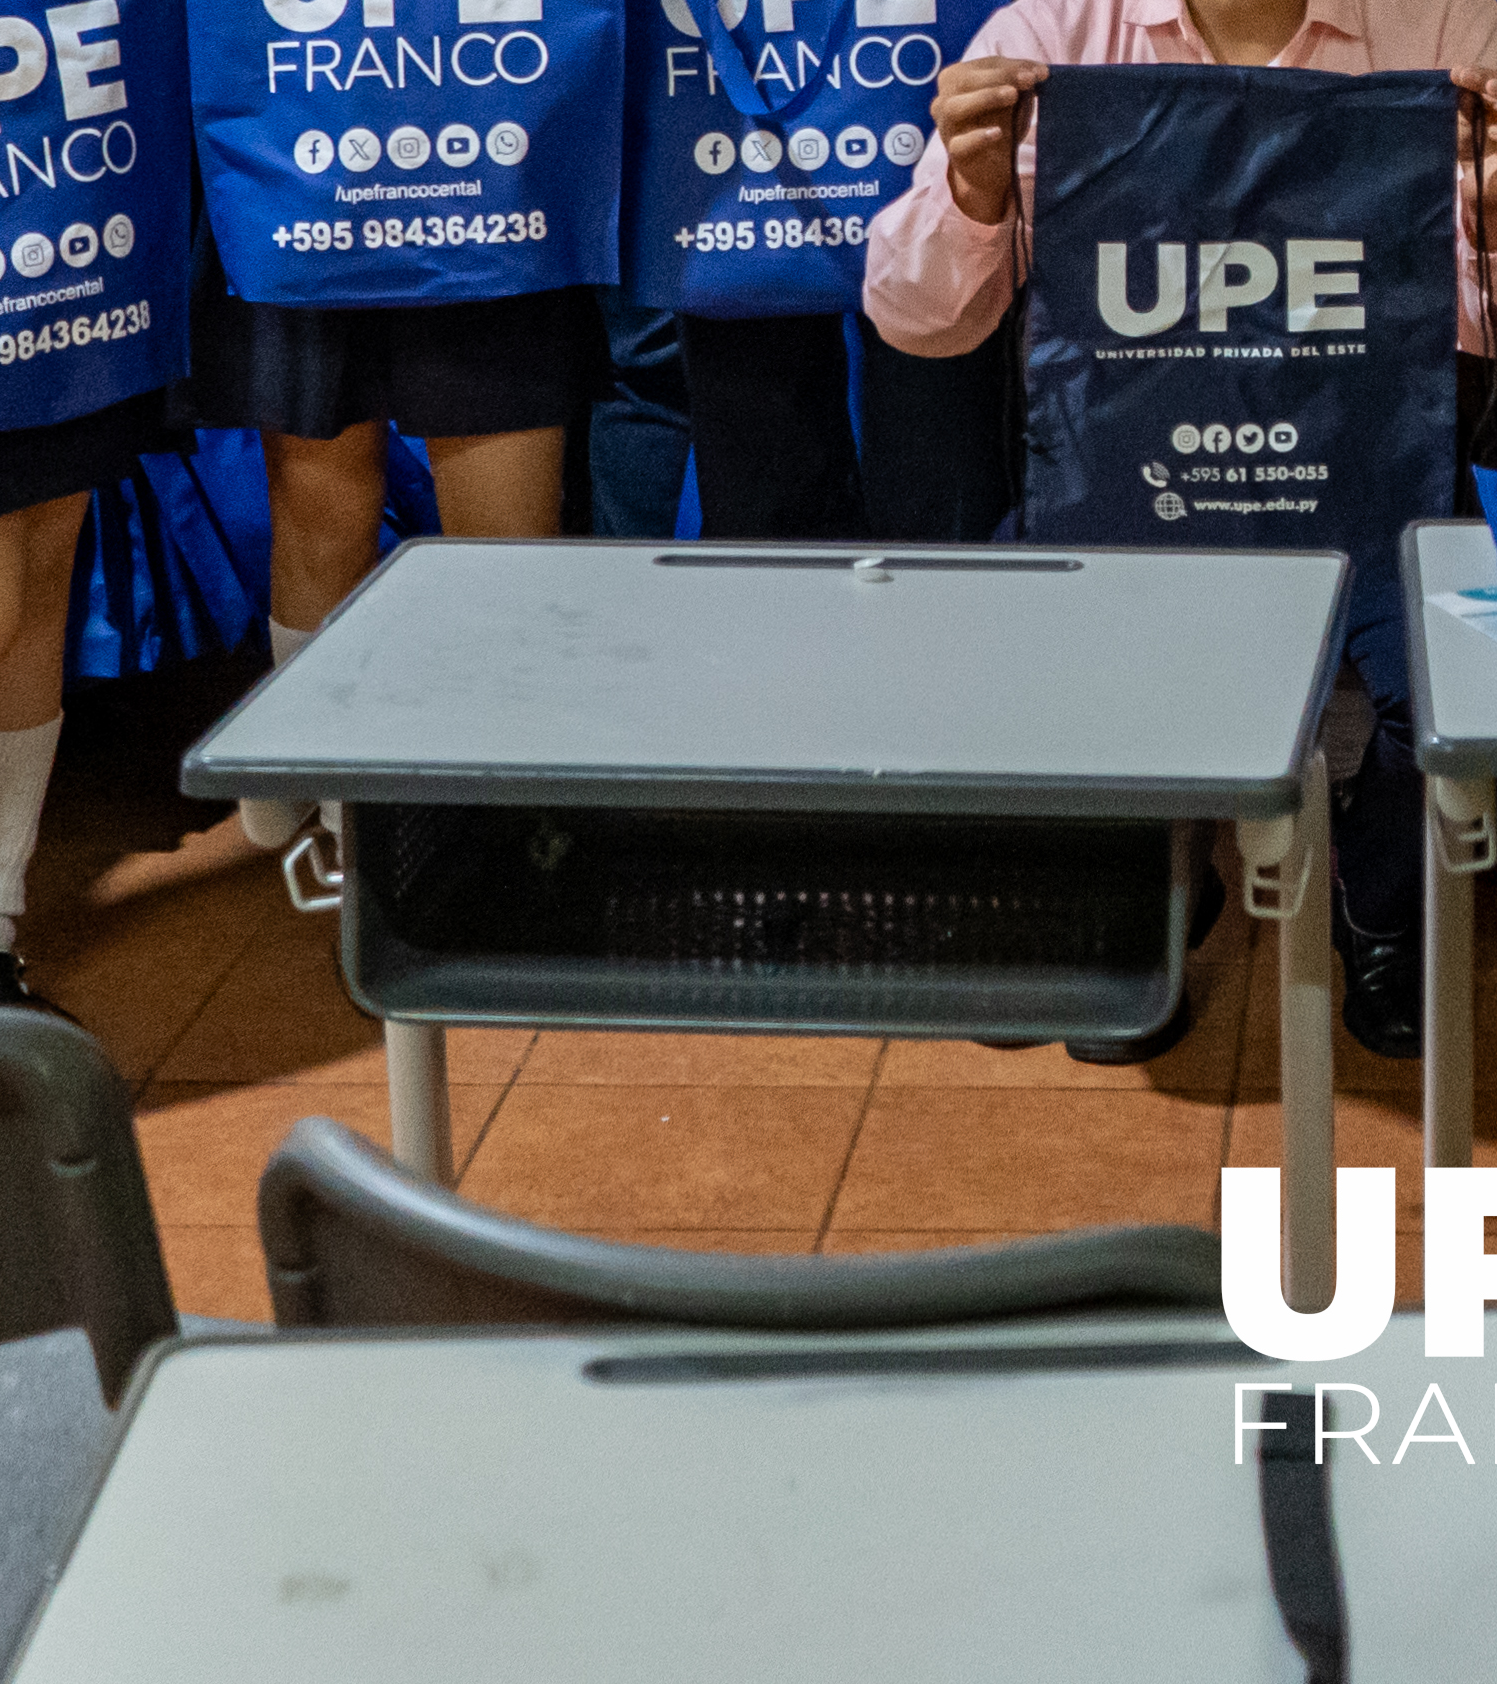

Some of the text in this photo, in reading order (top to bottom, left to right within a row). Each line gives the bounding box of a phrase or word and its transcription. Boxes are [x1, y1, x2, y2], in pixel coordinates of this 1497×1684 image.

[266, 31, 548, 93] FRANCO
[335, 180, 482, 203] /upefrancocental
[739, 181, 880, 203] /upefrancocental
[272, 211, 547, 252] +595 984364238
[674, 220, 755, 252] +595
[1097, 240, 1365, 337] UPE
[1095, 344, 1366, 360] UNIVERSIDAD PRIVADA DEL ESTE
[1181, 465, 1329, 482] +595 61 550-055
[1194, 496, 1318, 514] www.upe.edu.py
